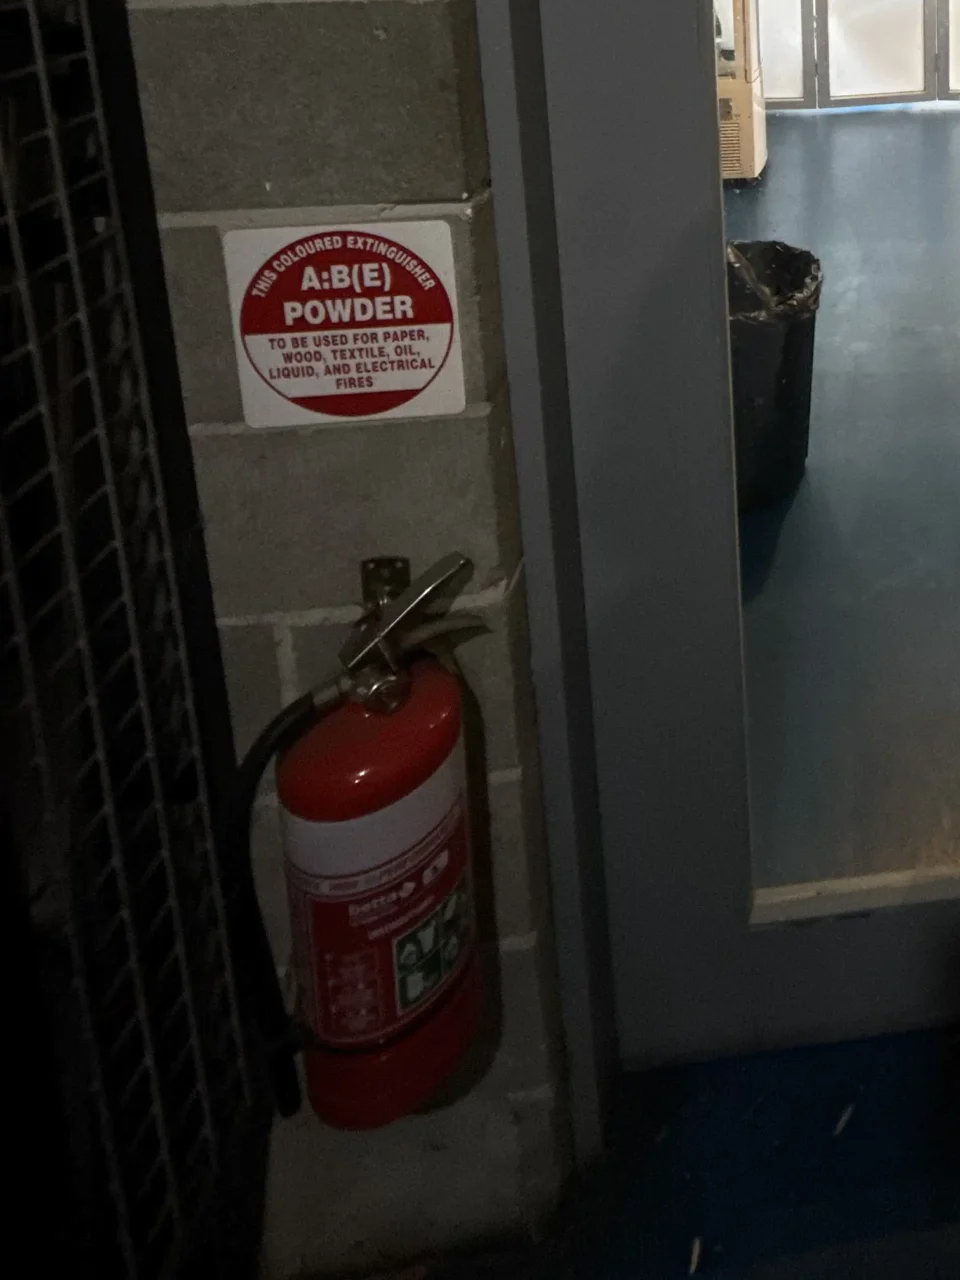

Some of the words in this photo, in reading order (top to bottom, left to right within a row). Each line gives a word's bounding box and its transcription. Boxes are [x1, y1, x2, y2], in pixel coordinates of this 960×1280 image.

[252, 270, 278, 298] THIS
[273, 236, 342, 271] COLOURED
[347, 236, 436, 291] EXTINGUISHER
[301, 262, 391, 292] A:B(E)
[283, 295, 415, 326] POWDER
[269, 338, 286, 350] TO
[292, 336, 308, 349] BE
[314, 333, 348, 348] USED
[353, 331, 379, 345] FOR
[384, 329, 430, 343] PAPER,
[283, 351, 327, 364] WOOD,
[332, 347, 390, 361] TEXTILE,
[395, 345, 421, 357] OIL,
[269, 365, 320, 379] LIQUID,
[324, 362, 350, 376] AND
[355, 358, 435, 374] ELECTRICAL
[336, 376, 374, 389] FIRES
